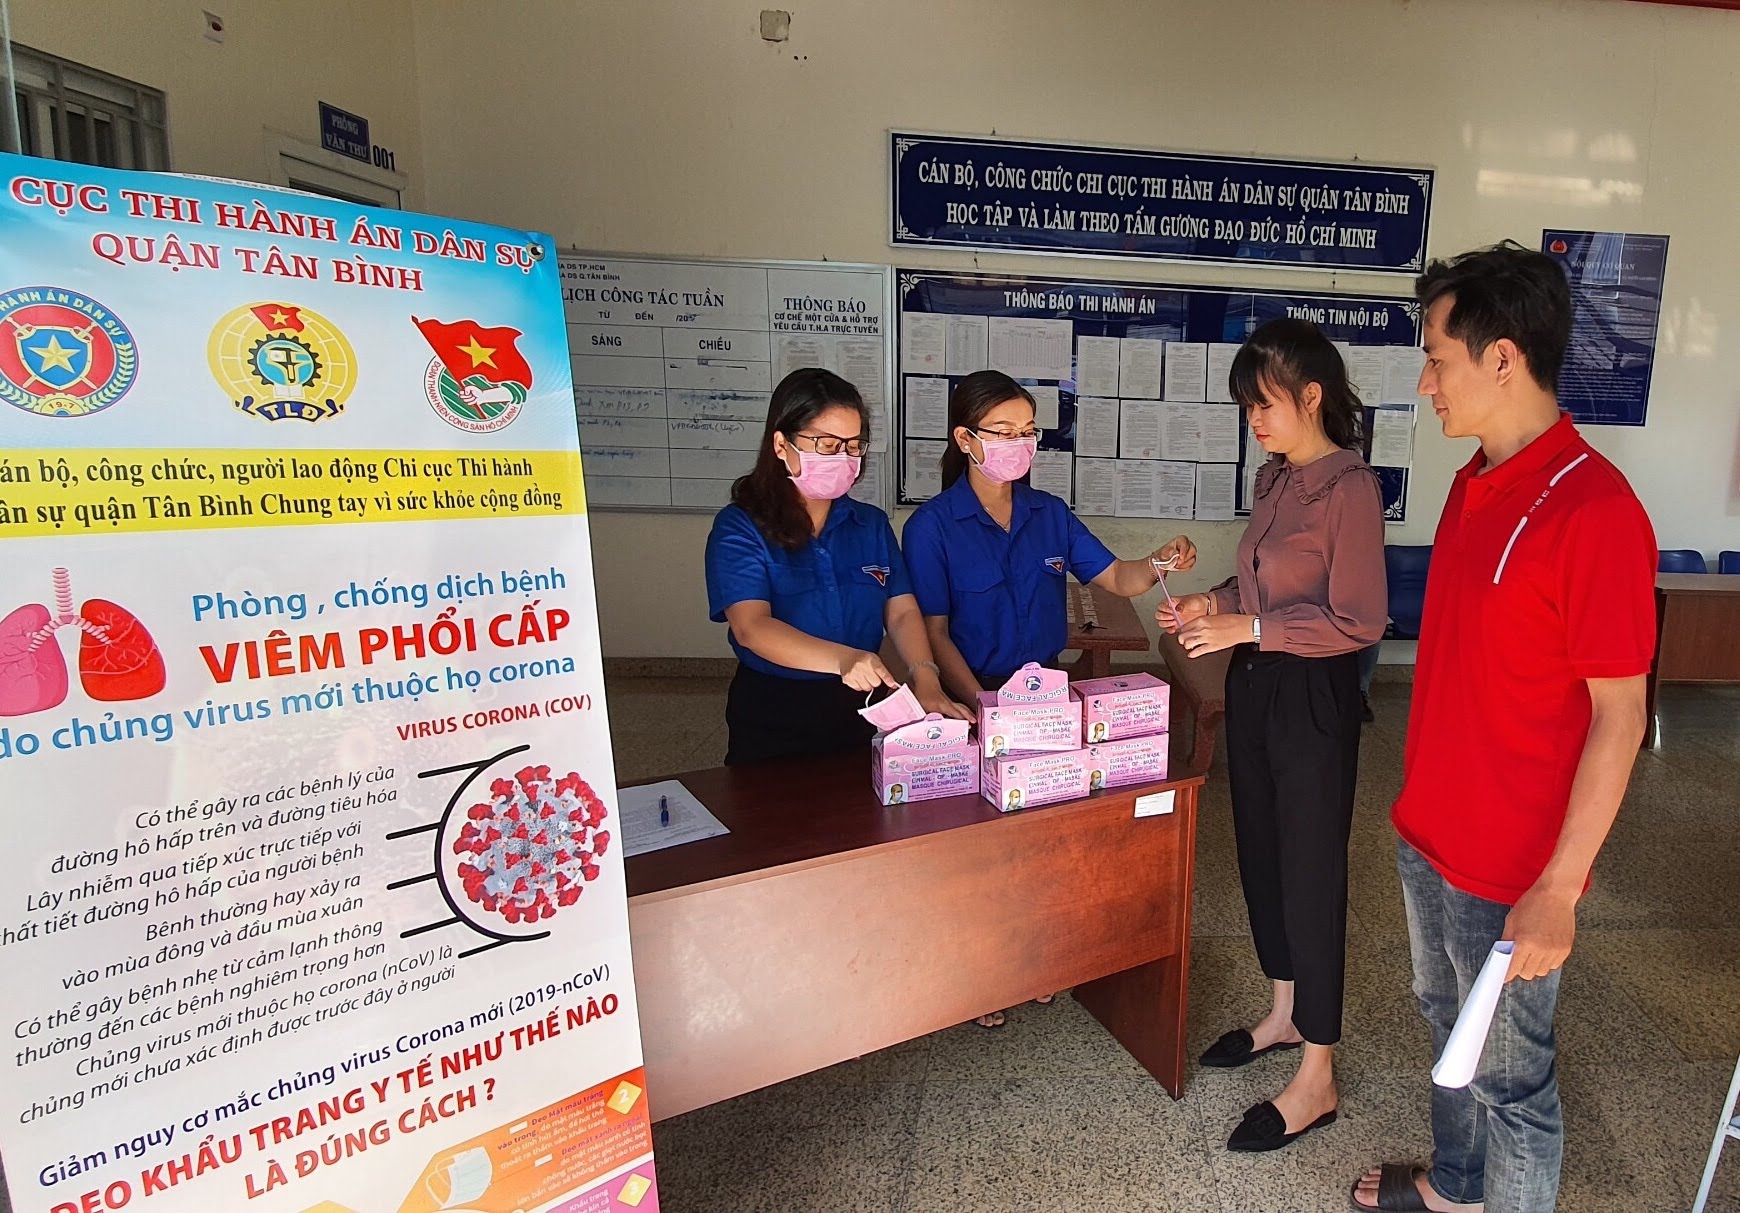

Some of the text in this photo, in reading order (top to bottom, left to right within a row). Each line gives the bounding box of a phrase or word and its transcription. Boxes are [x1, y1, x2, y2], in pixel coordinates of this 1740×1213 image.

[372, 144, 396, 172] 001
[918, 157, 1410, 215] CÁN BỘ, CÔNG CHỨC CHI CỤC THI HÀNH ÁN DÂN SỰ QUẬN TÂN BÌNH
[12, 177, 108, 214] CỤC
[121, 190, 202, 224] THI
[215, 200, 338, 241] HÀNH
[350, 217, 402, 250] ÁN
[413, 231, 485, 261] DÂN
[946, 200, 1378, 249] HỌC TẬP VÀ LÀM THEO TẤM GƯƠNG ĐẠO ĐỨC HỒ CHÍ MINH
[92, 233, 424, 291] QUẬN TÂN BÌNH
[561, 286, 724, 307] LỊCH CÔNG TÁC TUẦN
[783, 295, 866, 314] THÔNG BÁO
[1003, 287, 1156, 315] THÔNG BÁO THI HÀNH ÁN
[1286, 303, 1389, 331] THÔNG TIN NỘI BỘ
[591, 333, 622, 347] SÁNG
[38, 458, 79, 488] bộ,
[86, 458, 145, 487] công
[151, 458, 215, 484] chức,
[222, 458, 286, 485] người
[292, 458, 323, 479] lao
[329, 457, 379, 484] động
[383, 457, 418, 478] Chi
[423, 461, 453, 483] cục
[456, 457, 487, 477] Thi
[492, 457, 534, 477] hành
[37, 505, 66, 529] sự
[74, 497, 137, 528] quận
[142, 495, 192, 519] Tân
[197, 494, 254, 517] Bình
[260, 493, 333, 518] Chung
[338, 494, 368, 517] tay
[374, 491, 392, 511] vì
[396, 489, 428, 511] sức
[433, 489, 475, 509] khỏe
[480, 488, 519, 512] cộng
[523, 482, 563, 511] đồng
[192, 590, 308, 622] Phòng
[333, 577, 429, 609] chống
[436, 572, 495, 602] dịch
[501, 567, 567, 596] bệnh
[198, 599, 571, 684] VIÊM PHỔI CẤP
[0, 657, 576, 759] do chủng virus mới thuộc họ corona
[396, 694, 592, 741] VIRUS CORONA (COV)
[135, 766, 395, 829] Có thể gây ra các bệnh lý của
[39, 963, 611, 1188] Giảm nguy cơ mắc chủng virus Corona mới (2019-nCoV)
[141, 1135, 243, 1197] KHẨU
[250, 1087, 366, 1151] TRANG
[371, 1077, 391, 1104] Y
[396, 1053, 434, 1094] TẾ
[441, 1031, 504, 1079] NHƯ
[509, 1005, 561, 1051] THẾ
[566, 993, 620, 1031] NÀO
[245, 1159, 289, 1200] LÀ
[294, 1119, 392, 1178] ĐÚNG
[398, 1085, 478, 1135] CÁCH
[482, 1077, 496, 1101] ?
